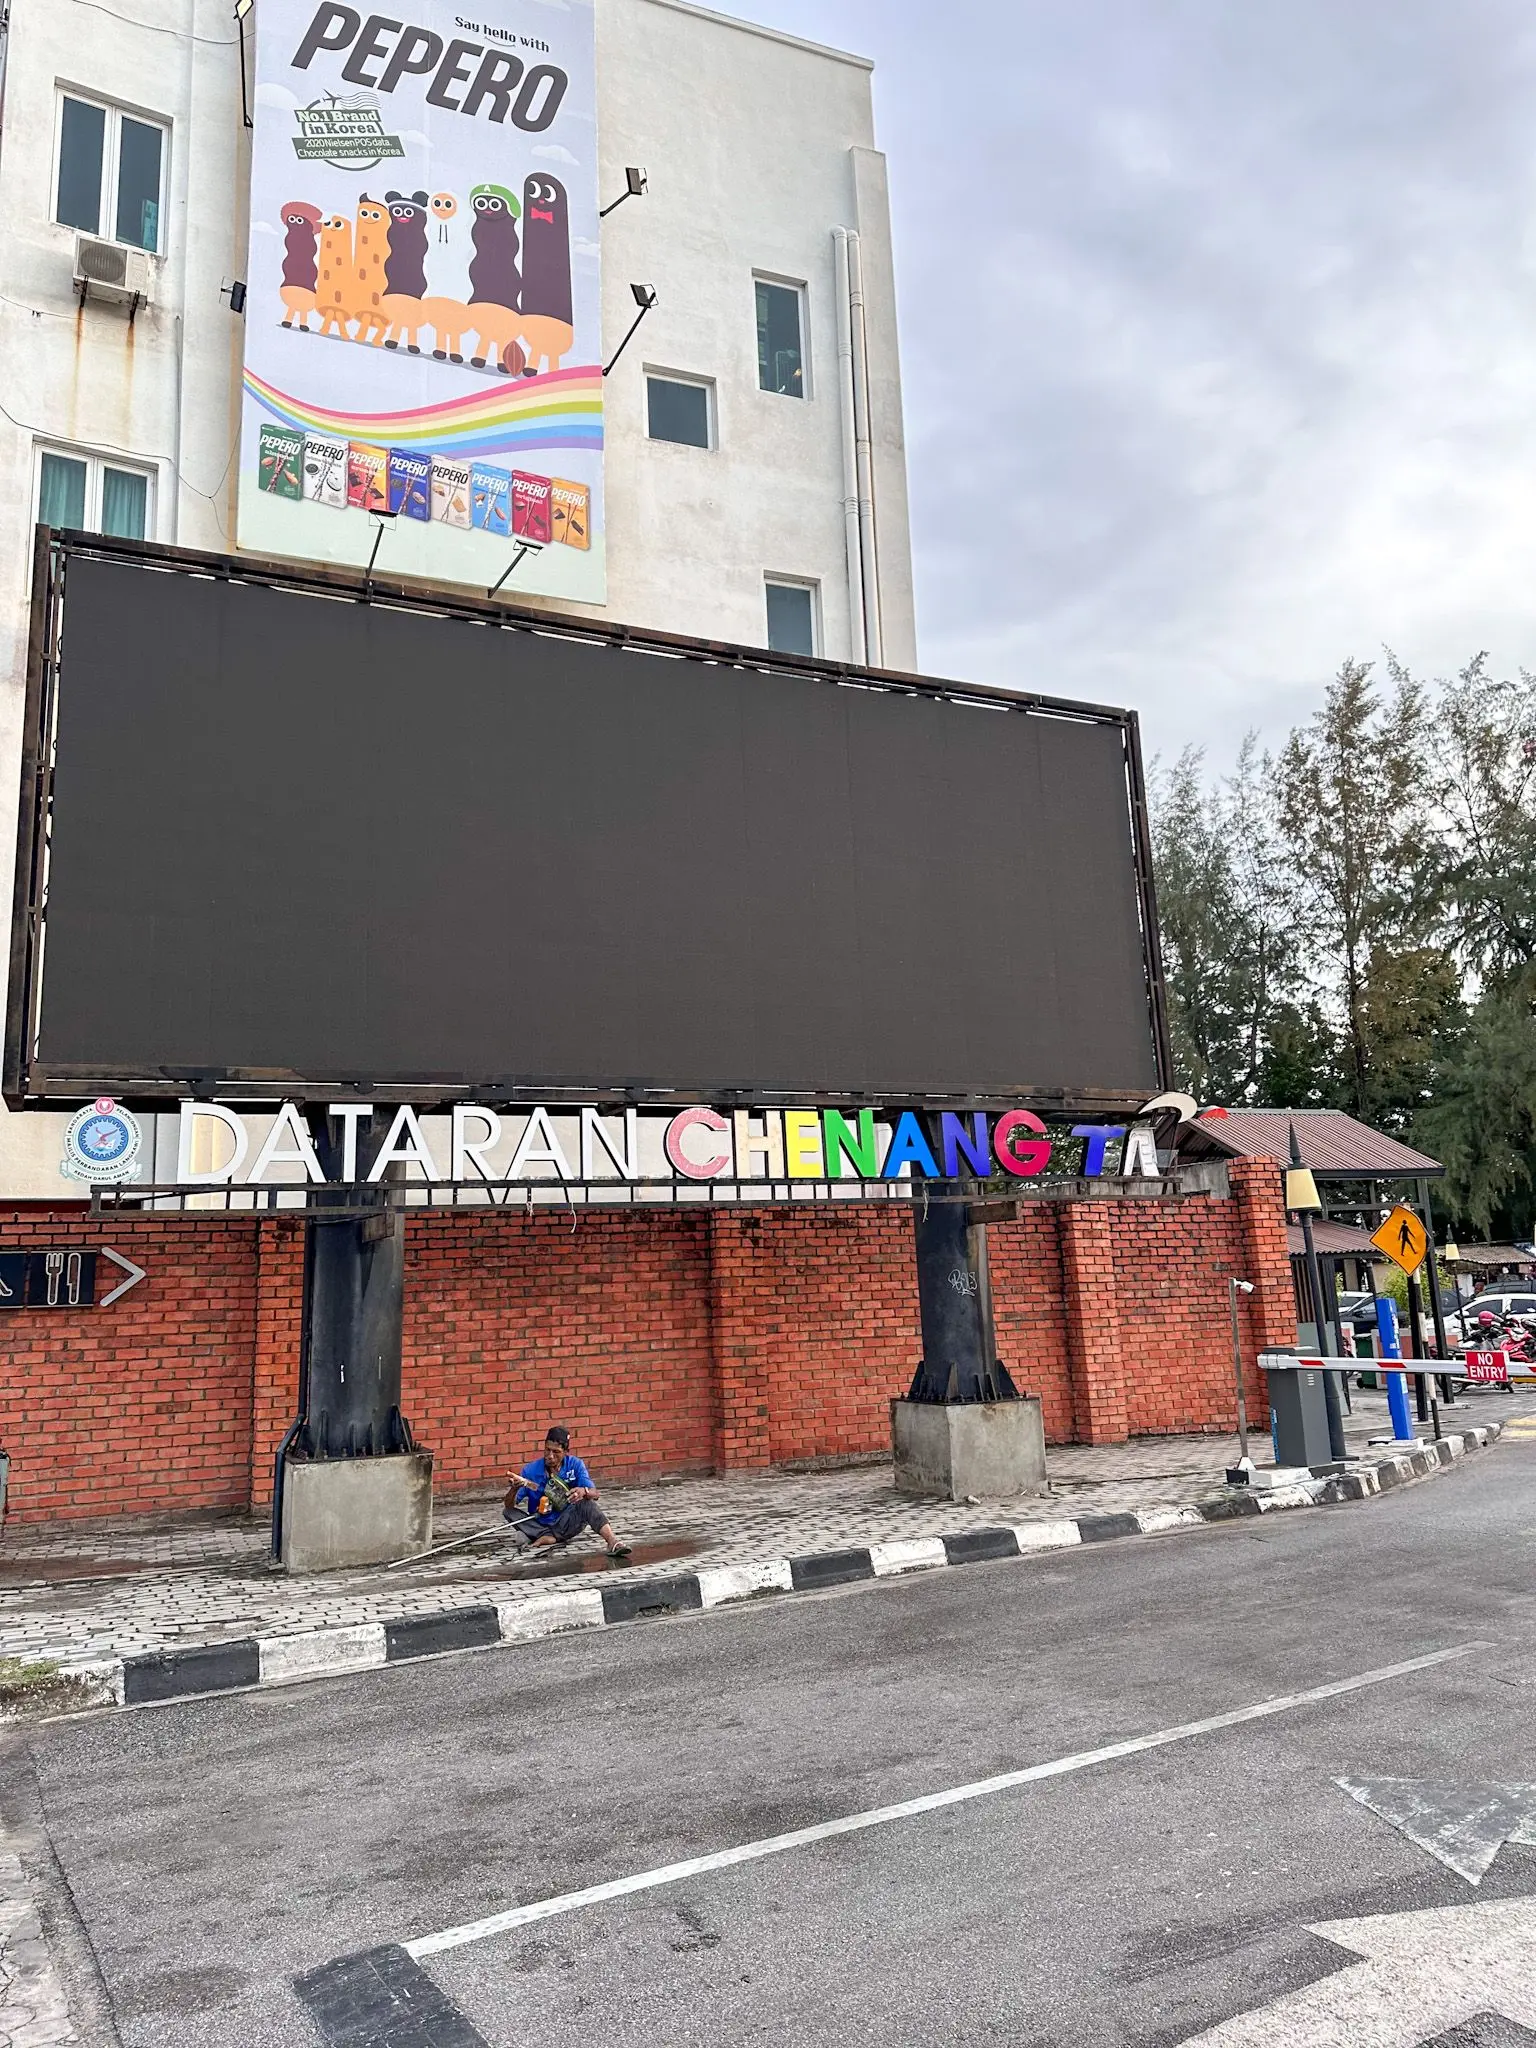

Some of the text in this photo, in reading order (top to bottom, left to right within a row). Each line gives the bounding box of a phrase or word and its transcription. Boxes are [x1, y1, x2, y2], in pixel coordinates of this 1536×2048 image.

[455, 16, 550, 53] Say hello with
[290, 1, 569, 133] PEPERO
[296, 110, 379, 122] No.1 Brand
[308, 122, 378, 135] in Korea
[297, 148, 338, 158] Chocolate
[339, 147, 368, 157] snacks
[368, 147, 377, 156] in
[305, 139, 325, 148] 2020
[325, 138, 356, 148] Nielsen
[355, 138, 371, 147] POS
[260, 434, 301, 455] PEPERO
[304, 441, 345, 461] PEPERO
[348, 451, 386, 471] PEPERO
[390, 456, 428, 477] PEPERO
[431, 465, 469, 485] PEPERO
[472, 473, 509, 492] PEPERO
[512, 478, 548, 498] PEPERO
[551, 487, 586, 506] PEPERO
[176, 1101, 639, 1185] DATARAN
[664, 1107, 1052, 1180] CHENANG
[73, 1156, 119, 1172] PERBANDARAN
[1477, 1353, 1494, 1366] NO
[1469, 1365, 1505, 1379] ENTRY
